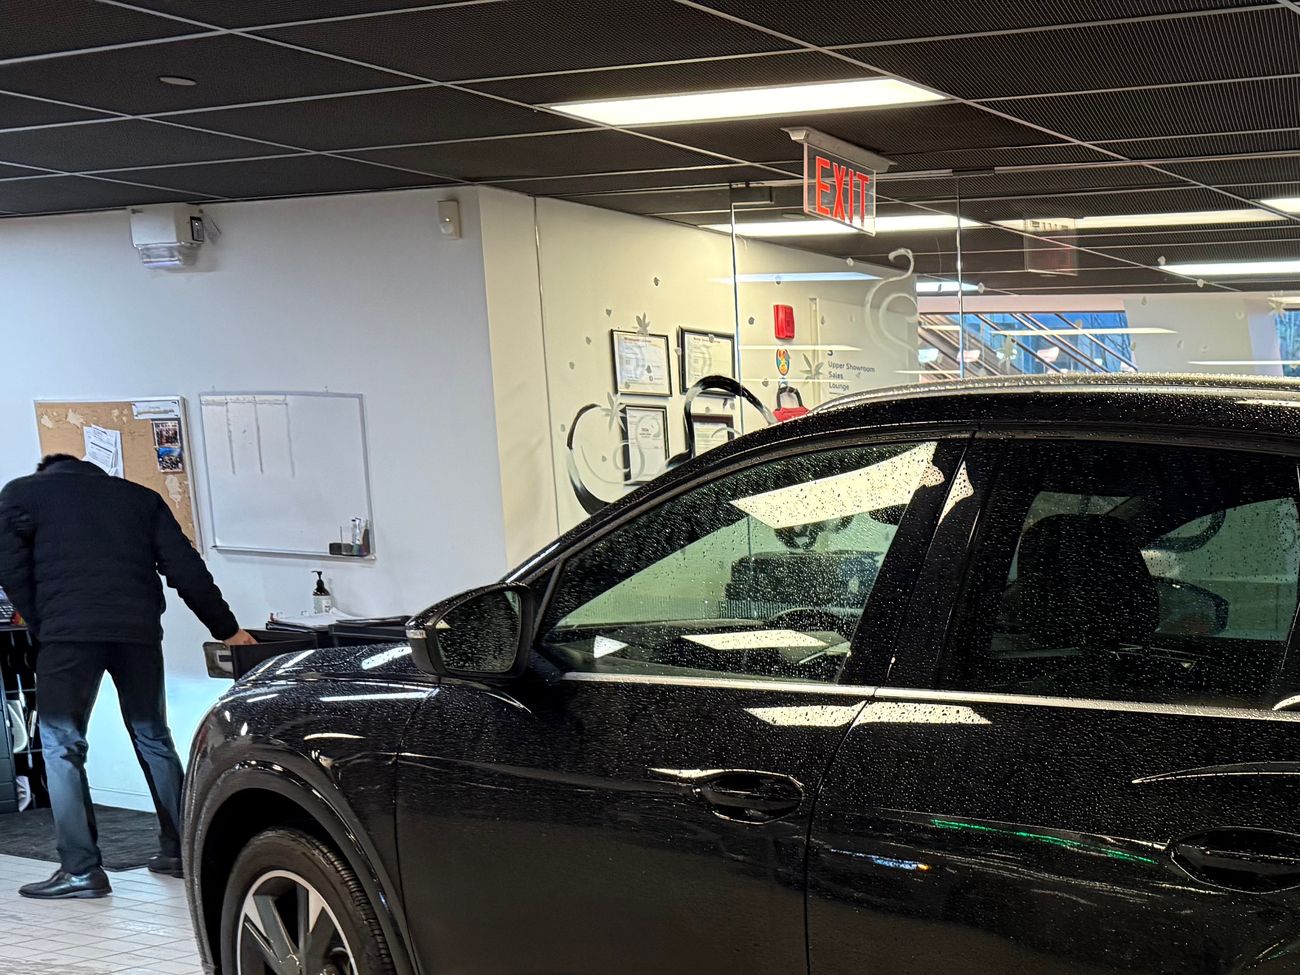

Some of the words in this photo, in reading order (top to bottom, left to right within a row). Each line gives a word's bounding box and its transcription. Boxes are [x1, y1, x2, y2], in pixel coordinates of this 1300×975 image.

[815, 155, 869, 228] EXIT
[828, 361, 845, 370] Upper
[846, 363, 875, 372] Showroom
[829, 371, 843, 379] Sales
[829, 382, 849, 391] Lounge
